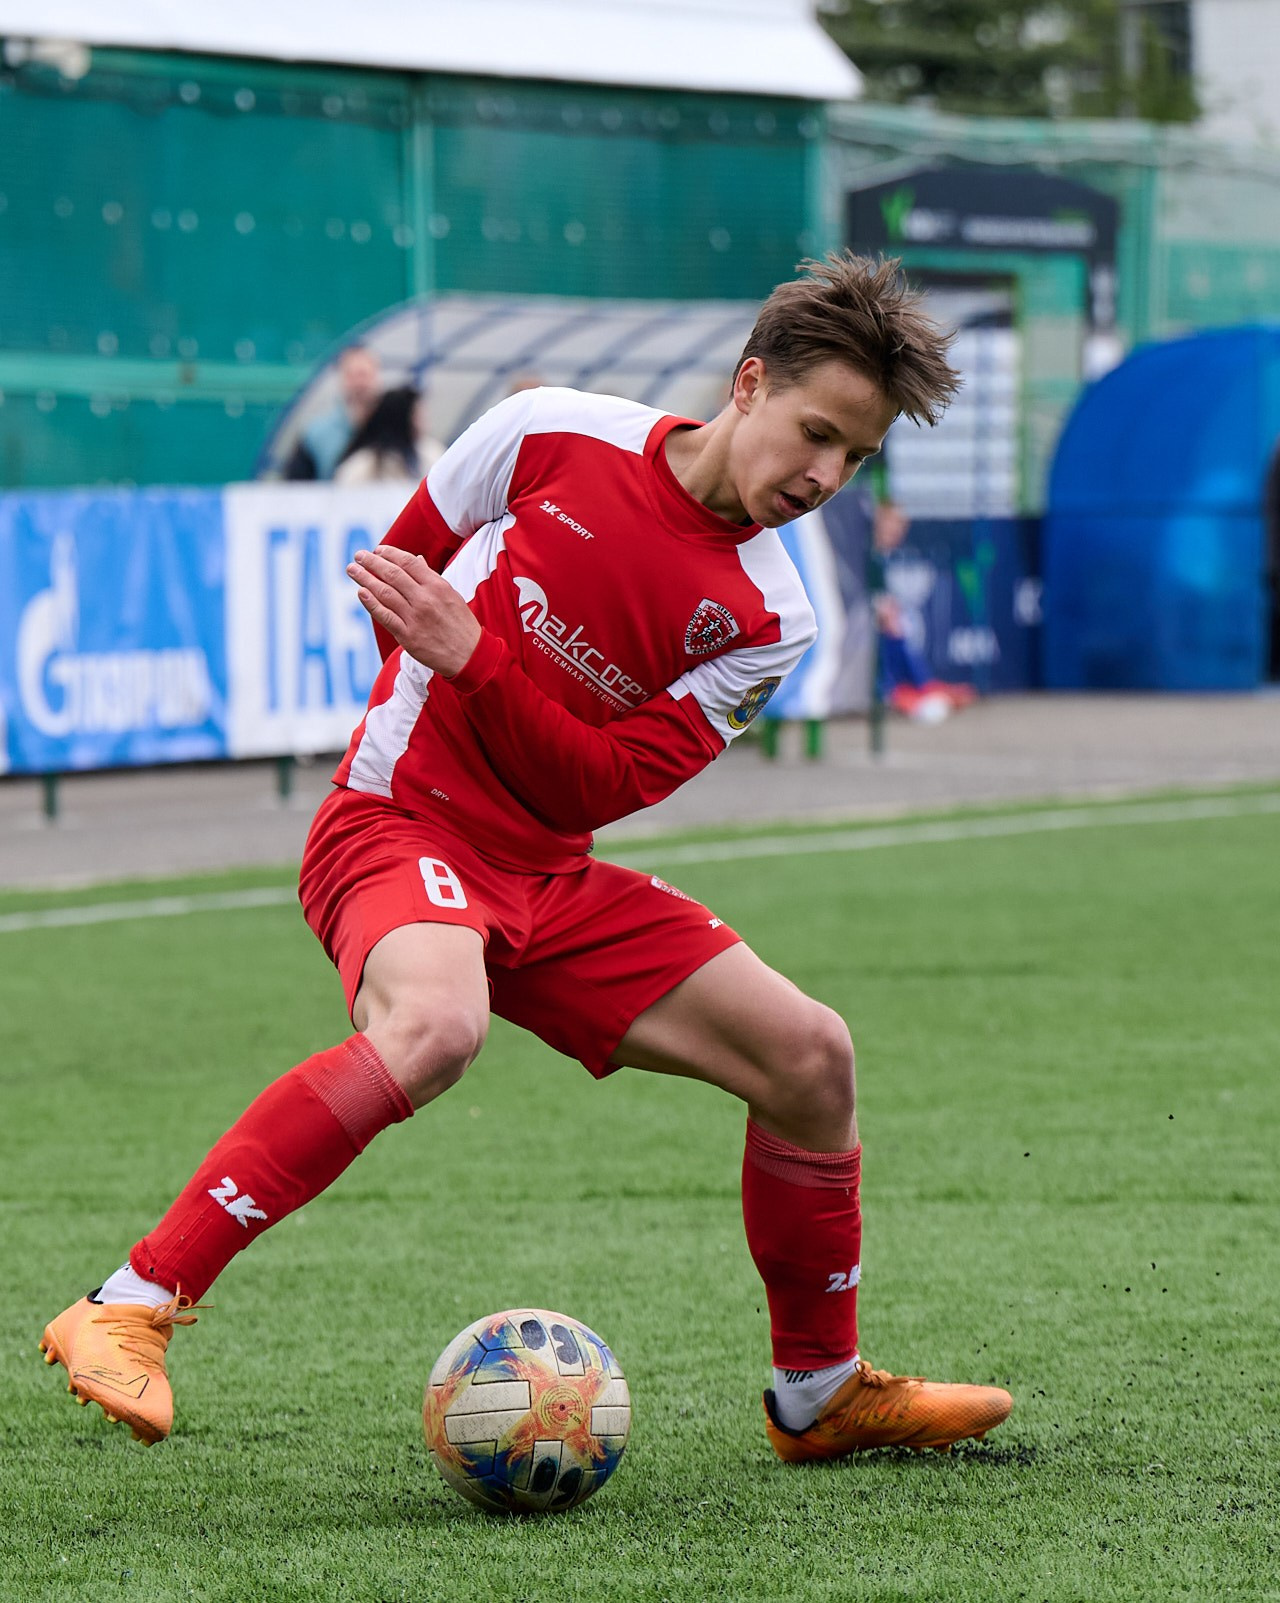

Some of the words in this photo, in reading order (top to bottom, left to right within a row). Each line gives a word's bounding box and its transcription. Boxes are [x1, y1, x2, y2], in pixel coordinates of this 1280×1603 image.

[539, 500, 562, 516] 2K
[556, 512, 595, 540] SPORT
[532, 637, 584, 683] СИСТЕМНАЯ
[418, 856, 468, 910] 8
[207, 1176, 268, 1229] 2K
